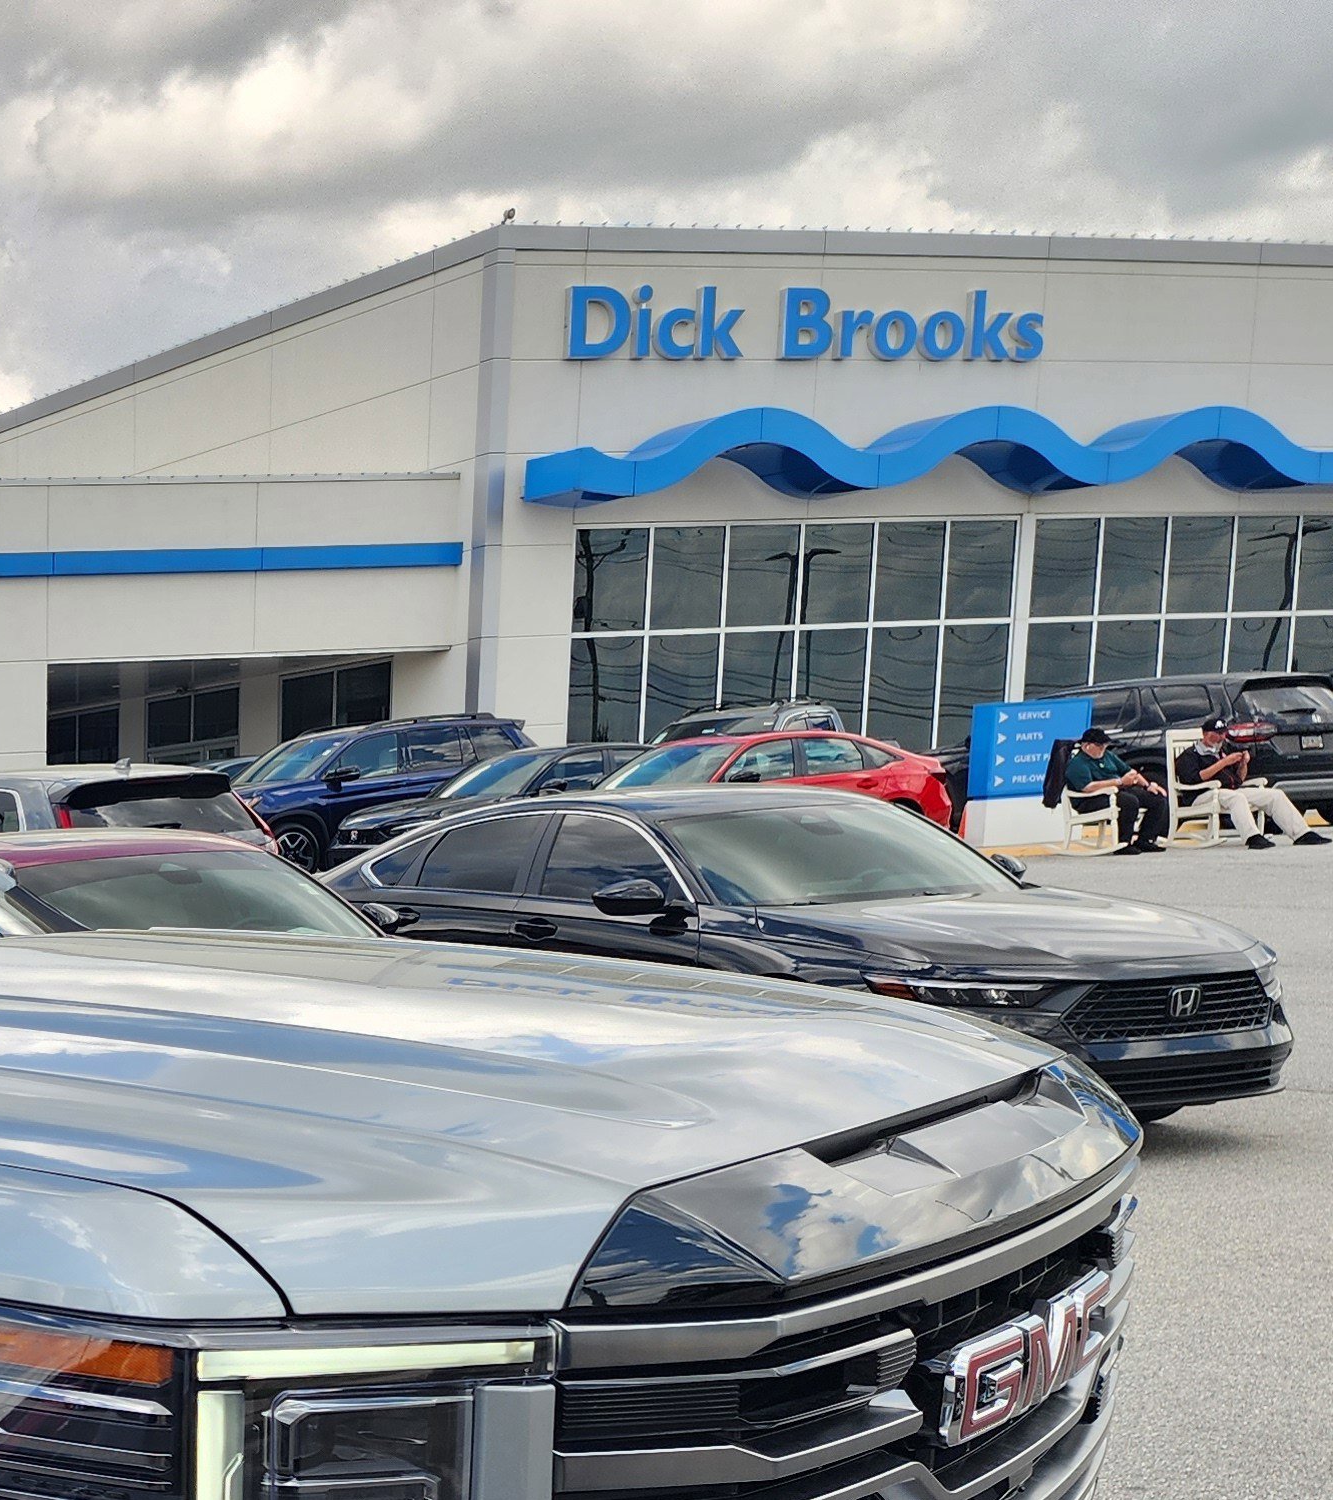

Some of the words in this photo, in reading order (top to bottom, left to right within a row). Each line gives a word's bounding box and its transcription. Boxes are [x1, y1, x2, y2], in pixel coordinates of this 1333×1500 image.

[565, 285, 746, 360] Dick
[779, 287, 1044, 361] Brooks
[1018, 710, 1051, 720] SERVICE
[1016, 732, 1043, 741] PARTS
[1014, 753, 1041, 763] GUEST
[1012, 773, 1046, 784] PRE-OW
[940, 1271, 1110, 1447] GMC
